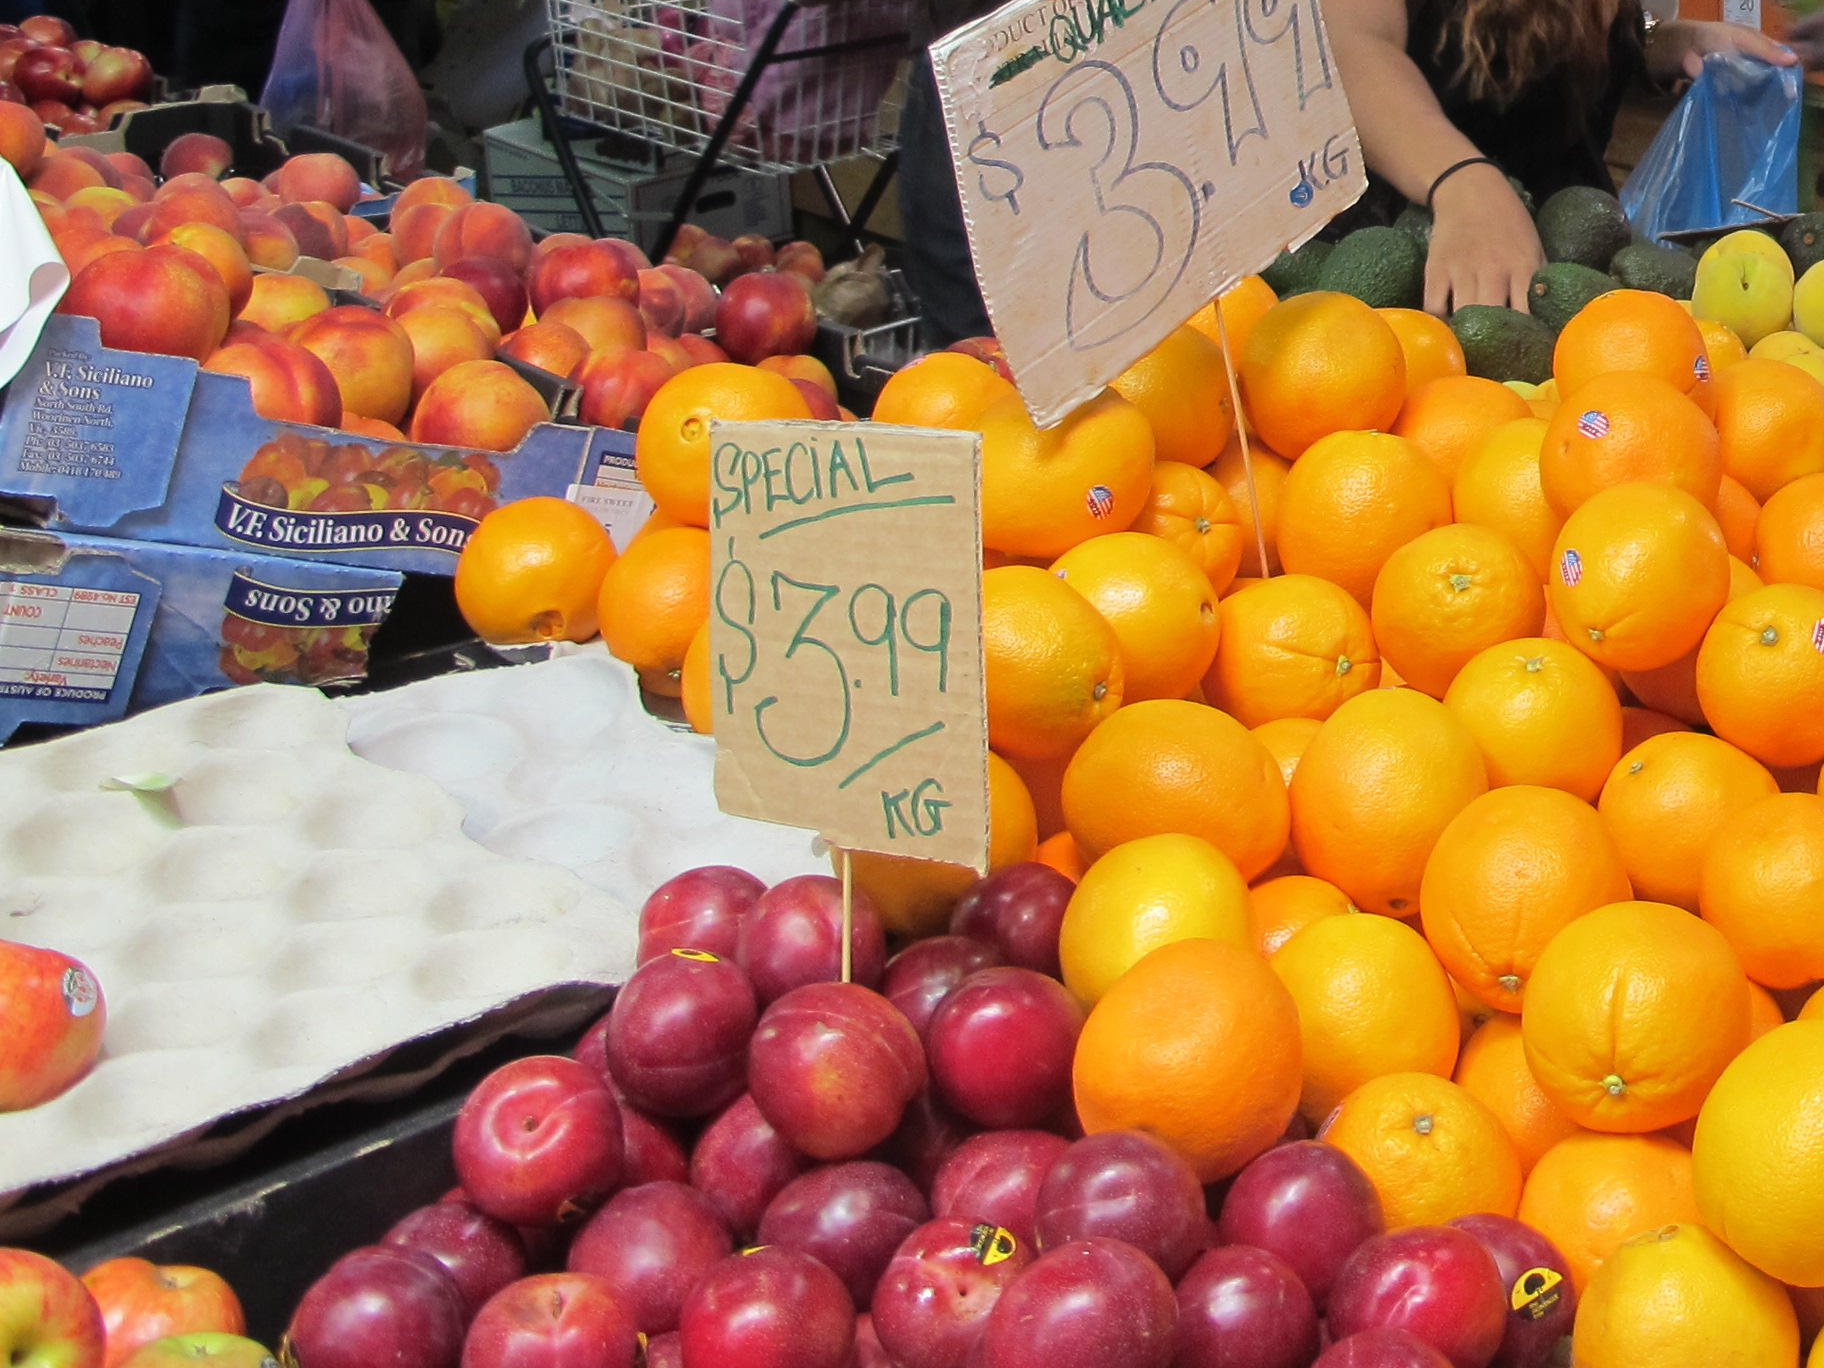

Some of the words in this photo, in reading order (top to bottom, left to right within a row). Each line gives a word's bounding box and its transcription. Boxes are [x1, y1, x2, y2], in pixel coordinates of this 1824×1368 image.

[77, 364, 155, 390] Siciliano
[39, 380, 55, 397] &
[58, 381, 102, 401] Sons
[712, 435, 915, 529] SPECIAL
[226, 503, 267, 537] V.F.
[271, 513, 385, 547] Siciliano
[389, 516, 412, 544] &
[20, 585, 59, 598] CLASS
[2, 602, 43, 619] COUNT
[244, 588, 314, 622] Sons
[320, 597, 342, 621] &
[77, 634, 124, 650] Peaches
[714, 535, 952, 768] $3.99
[57, 655, 117, 672] Nectarines
[35, 686, 53, 697] OF
[54, 688, 107, 701] PRODUCE
